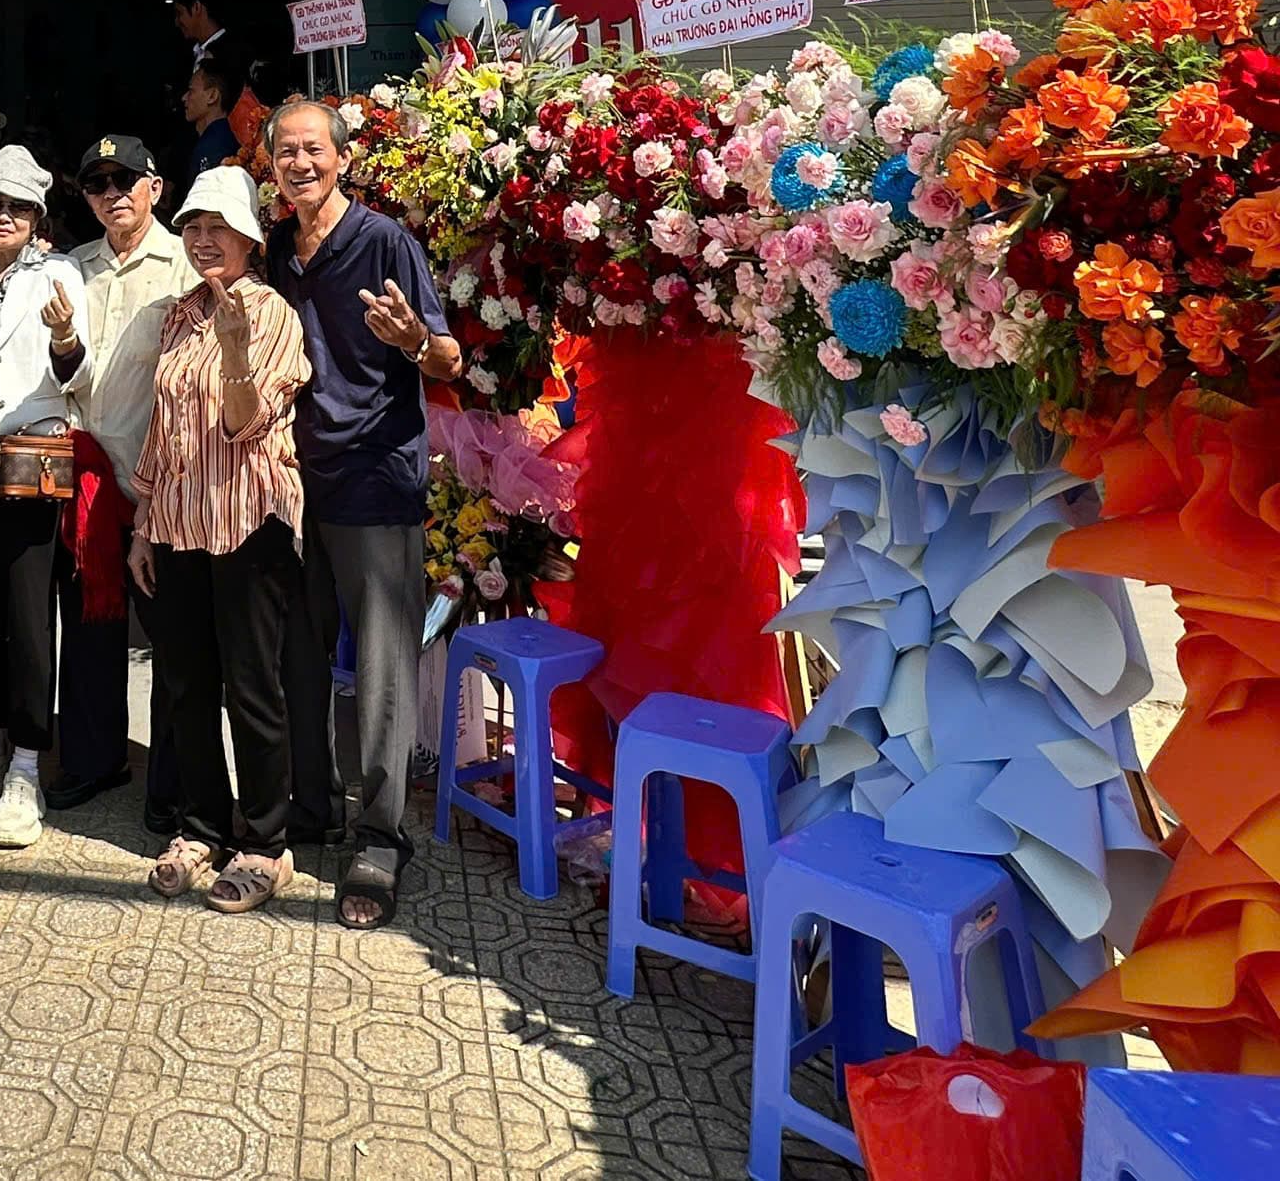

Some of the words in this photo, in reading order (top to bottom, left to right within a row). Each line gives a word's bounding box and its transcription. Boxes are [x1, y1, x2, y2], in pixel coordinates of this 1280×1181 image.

[651, 31, 674, 48] KHAI
[676, 22, 717, 43] TRƯƠNG
[720, 18, 738, 35] ĐẠI
[776, 0, 805, 22] PHÁT
[662, 3, 698, 26] CHÚC
[700, 1, 721, 16] GĐ
